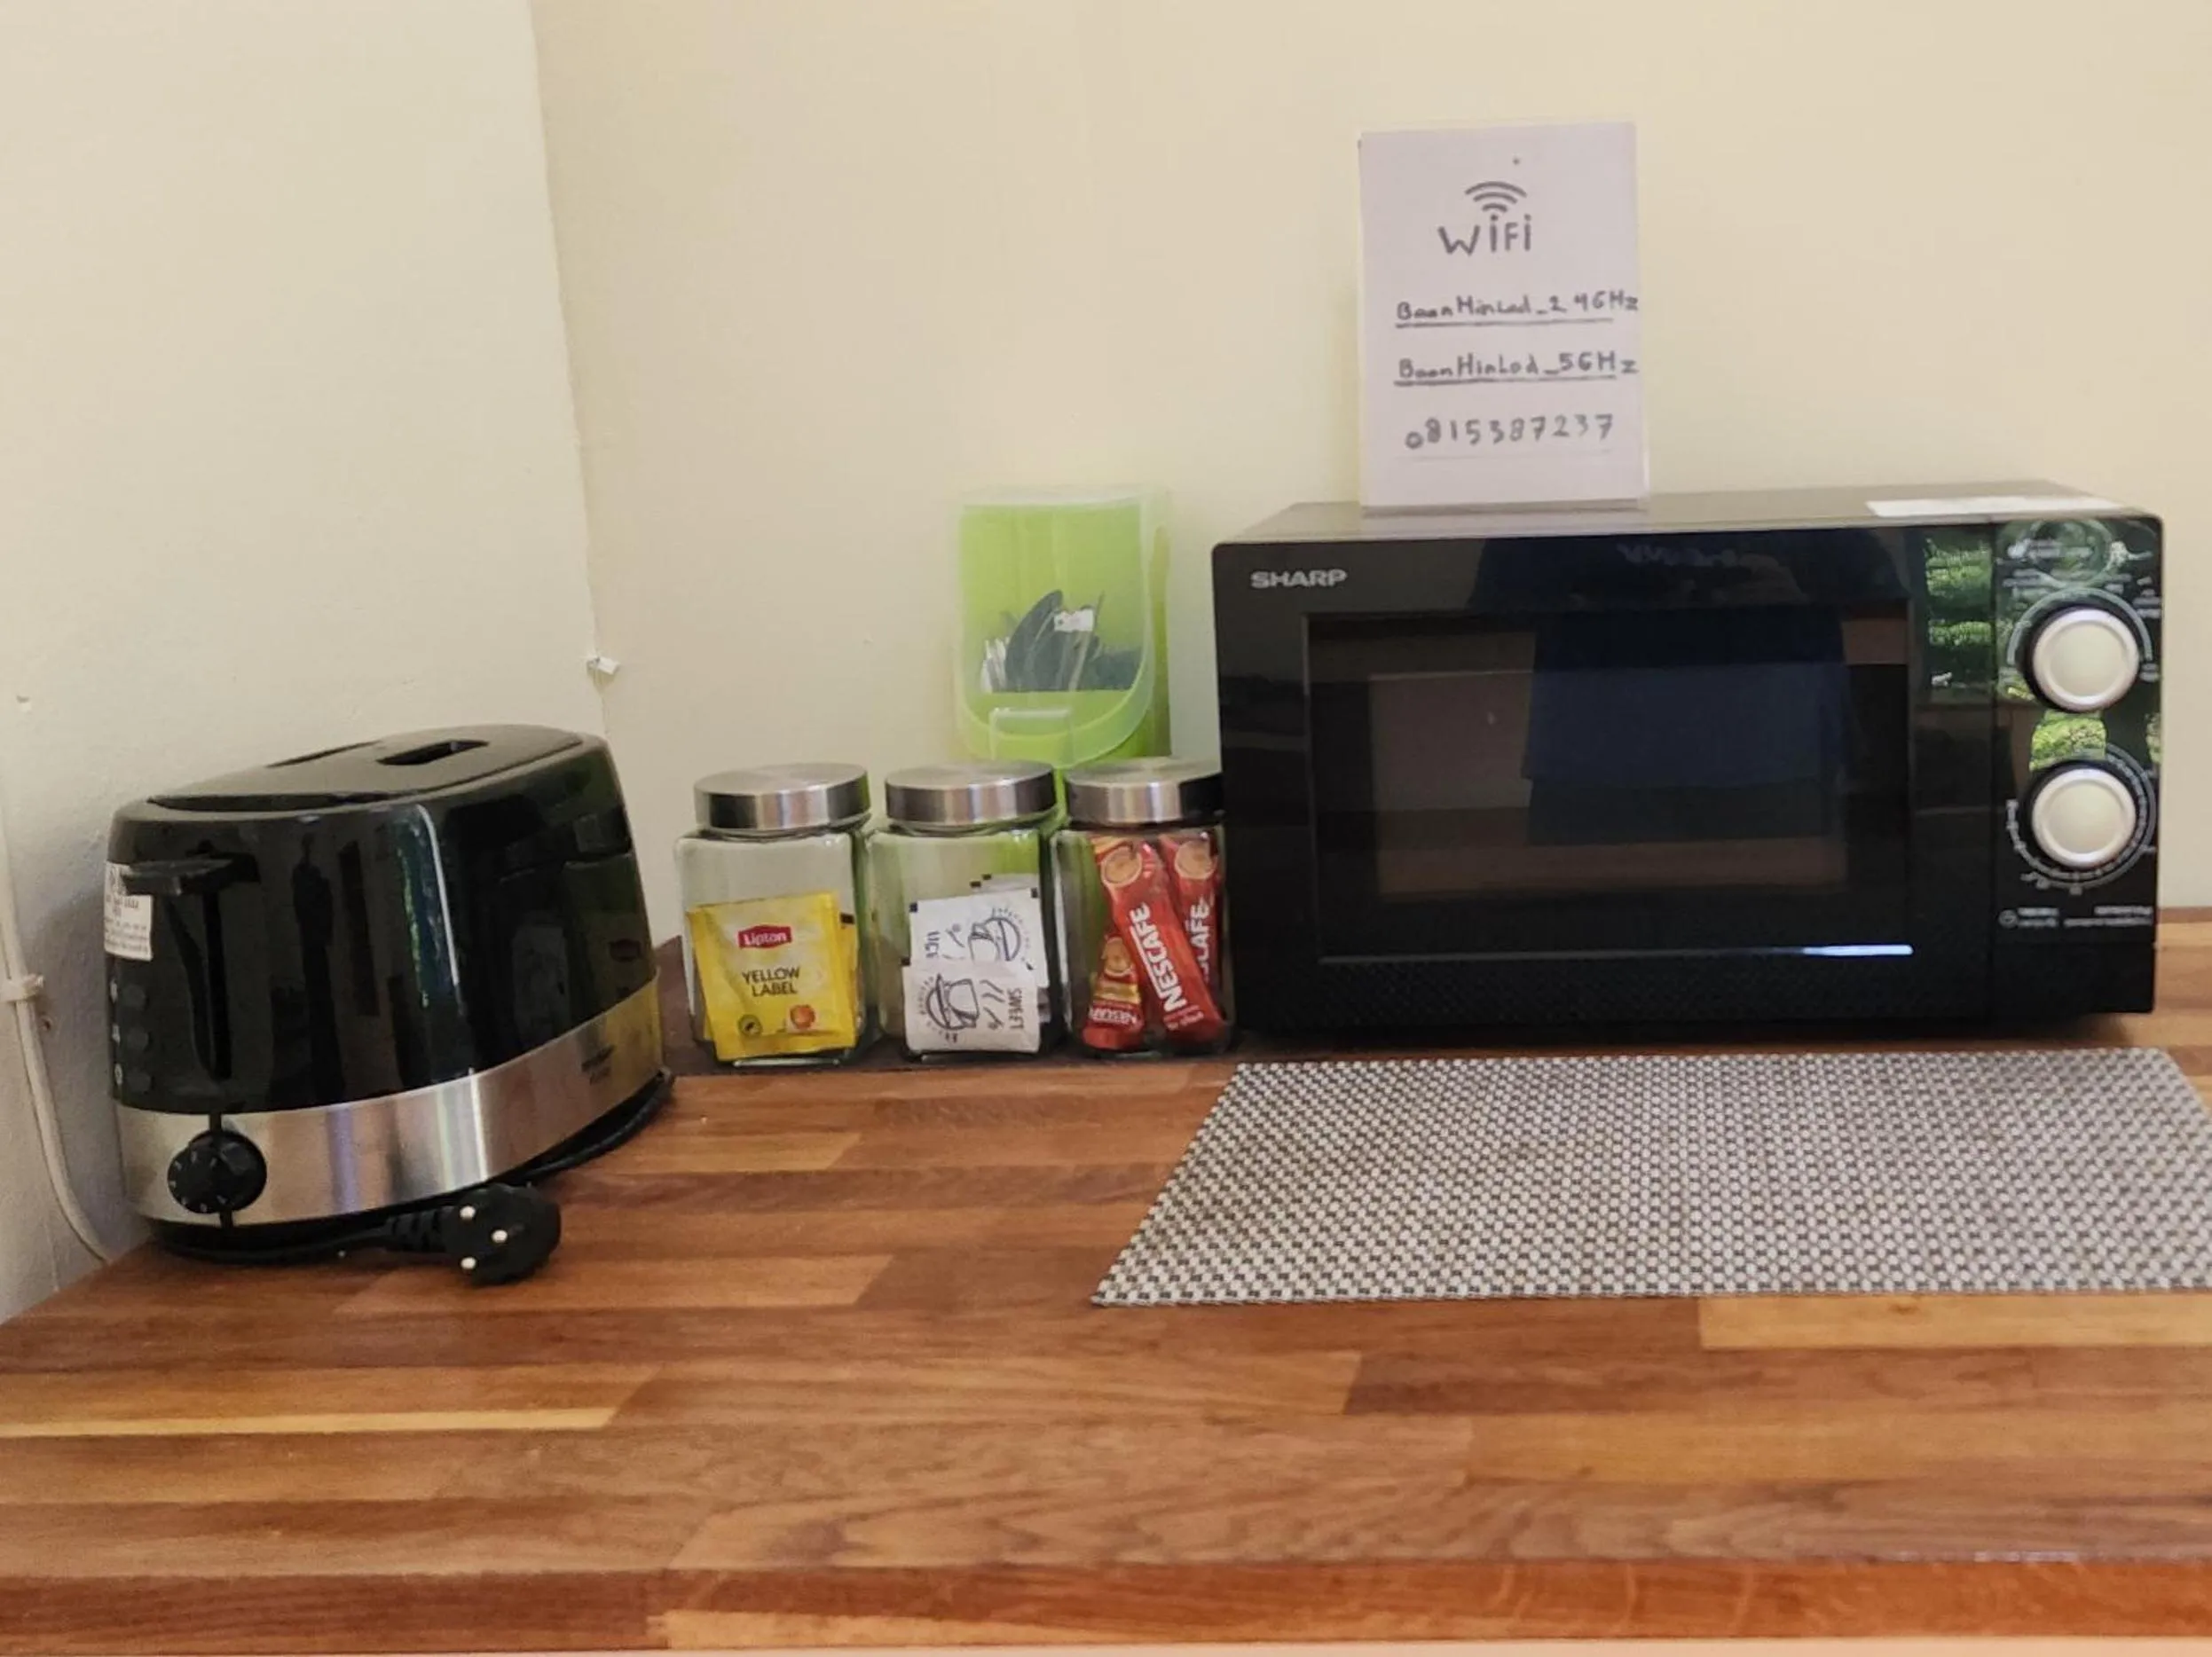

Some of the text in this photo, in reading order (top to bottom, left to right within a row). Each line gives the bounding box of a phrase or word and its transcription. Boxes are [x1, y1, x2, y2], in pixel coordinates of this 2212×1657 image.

[1250, 569, 1348, 588] SHARP
[744, 931, 787, 946] Lipton
[742, 966, 800, 985] YELLOW
[752, 981, 798, 997] LABEL
